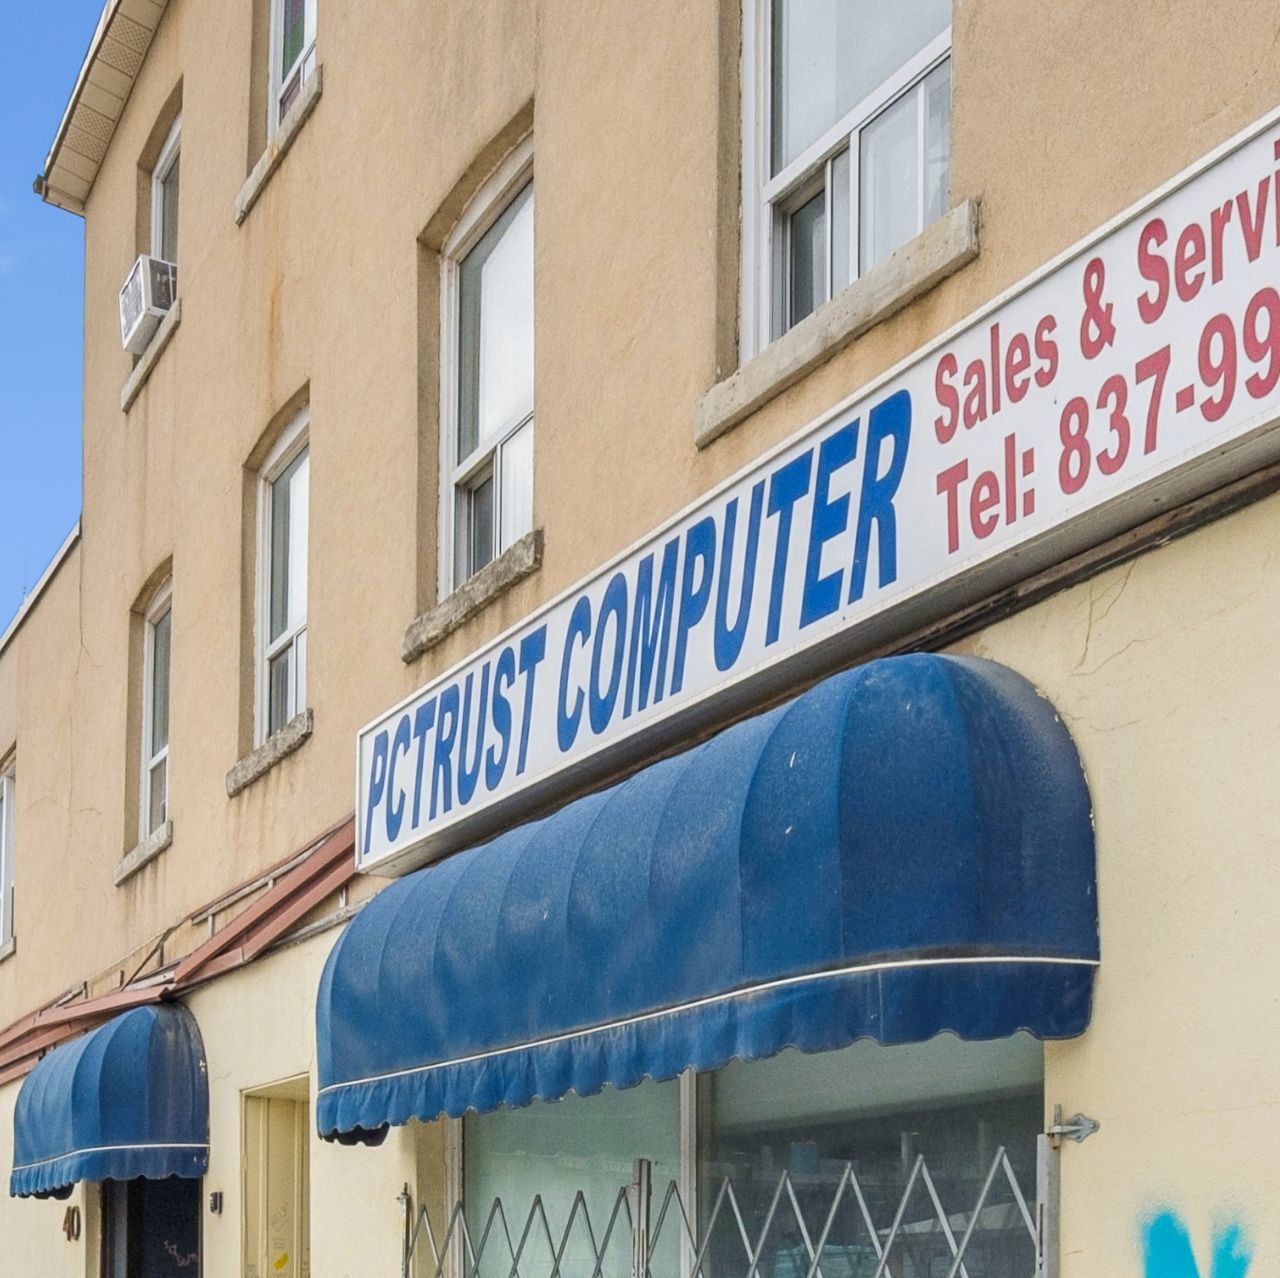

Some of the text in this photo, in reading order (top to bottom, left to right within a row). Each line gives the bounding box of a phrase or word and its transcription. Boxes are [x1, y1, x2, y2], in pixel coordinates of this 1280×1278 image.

[935, 315, 1059, 443] Sales
[1081, 258, 1116, 358] &
[937, 435, 1035, 552] Tel:
[364, 388, 914, 851] PCTRUST COMPUTER
[63, 1206, 81, 1241] 40
